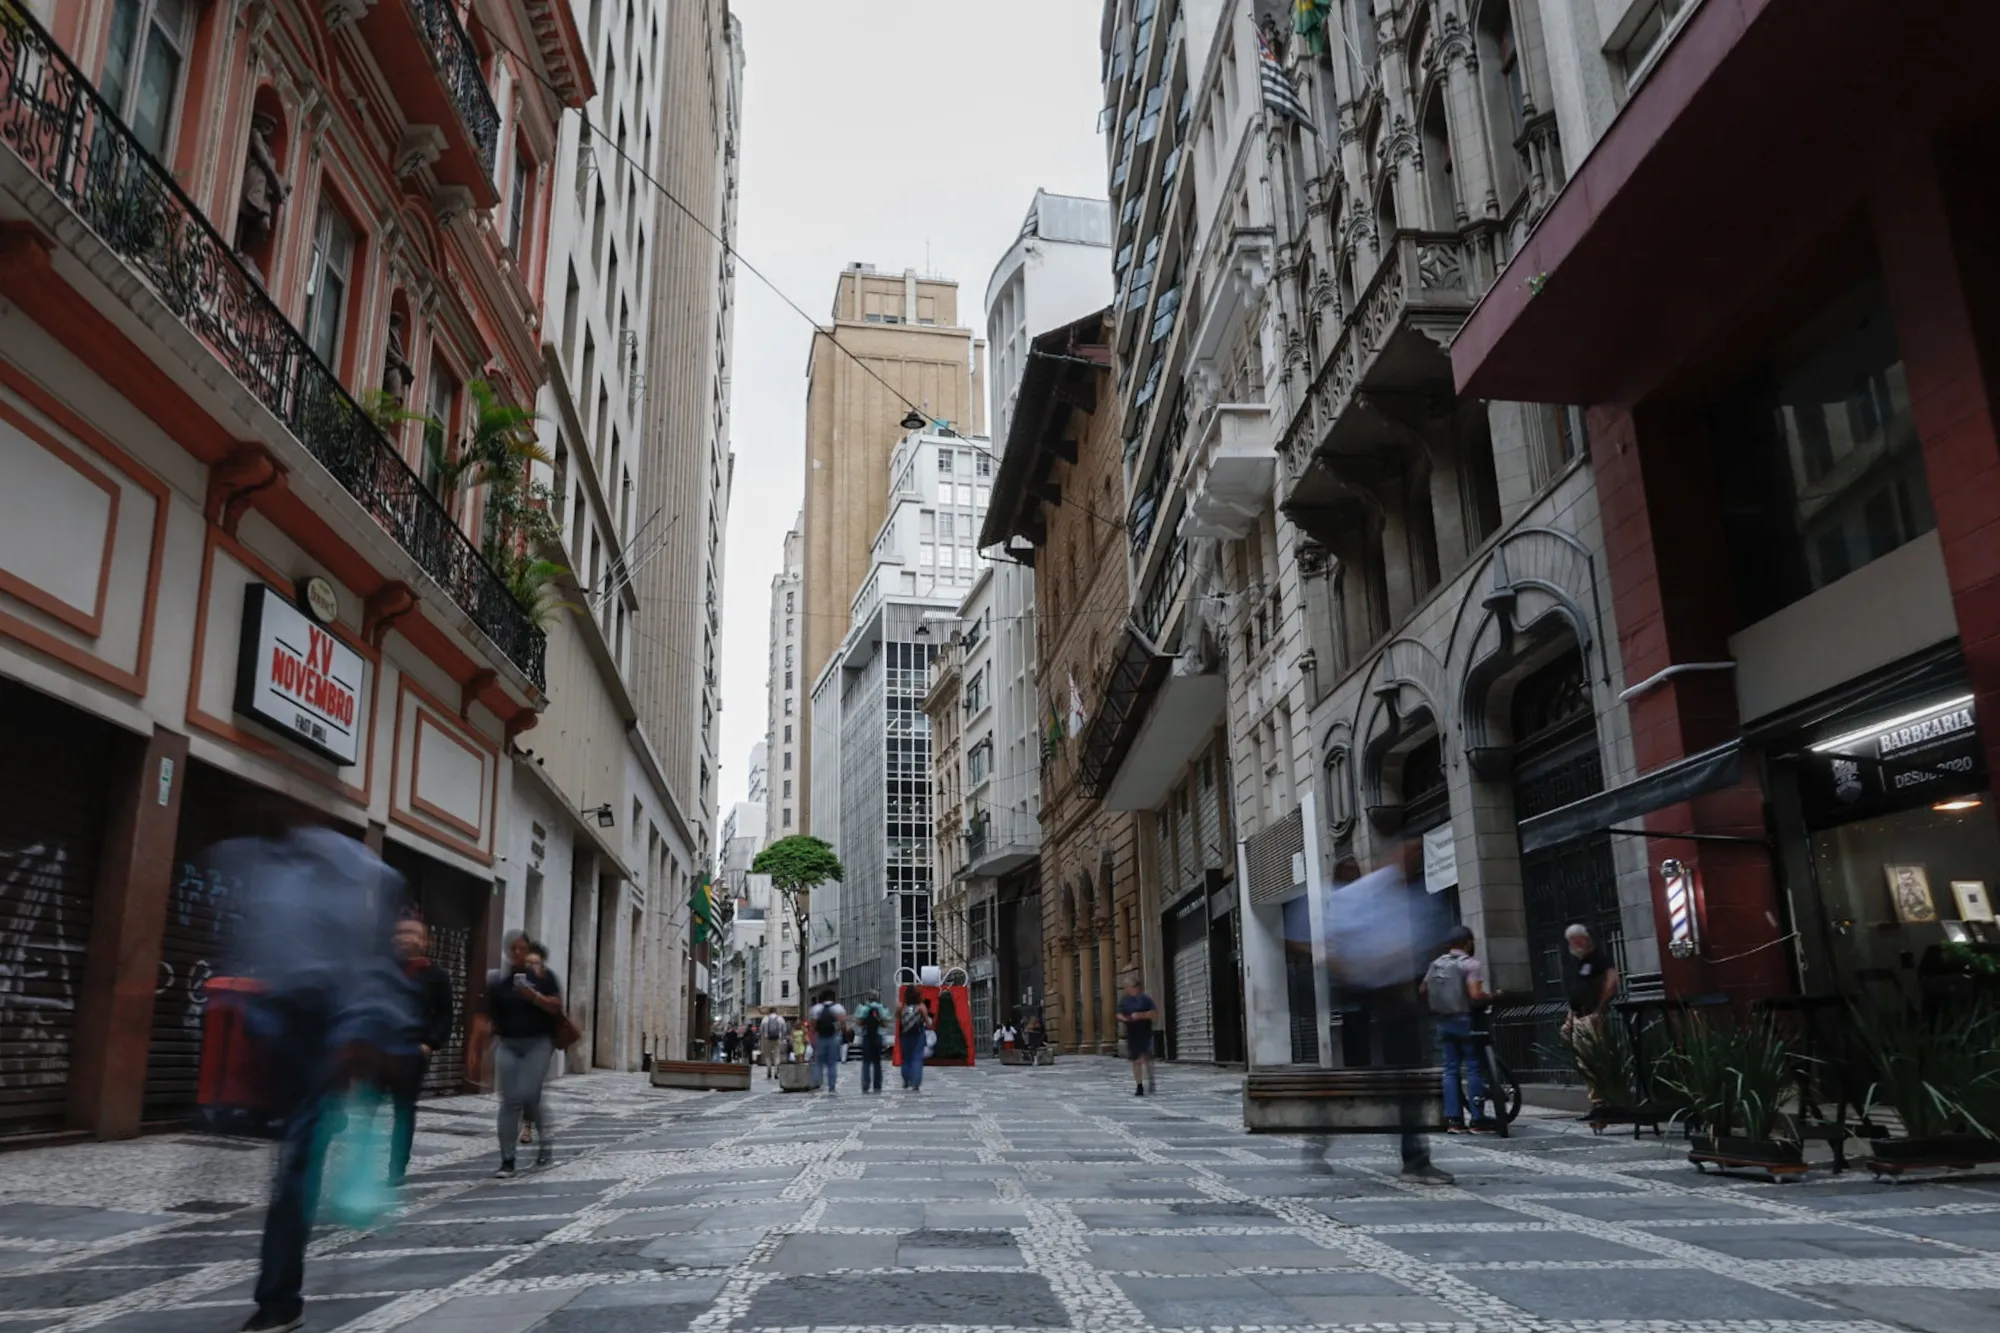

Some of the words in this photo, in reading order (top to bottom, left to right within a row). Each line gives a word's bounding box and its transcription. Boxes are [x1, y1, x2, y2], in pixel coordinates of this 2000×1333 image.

[307, 624, 334, 676] XV
[272, 647, 354, 726] NOVEMBRO
[1880, 708, 1974, 752] BARBEARIA
